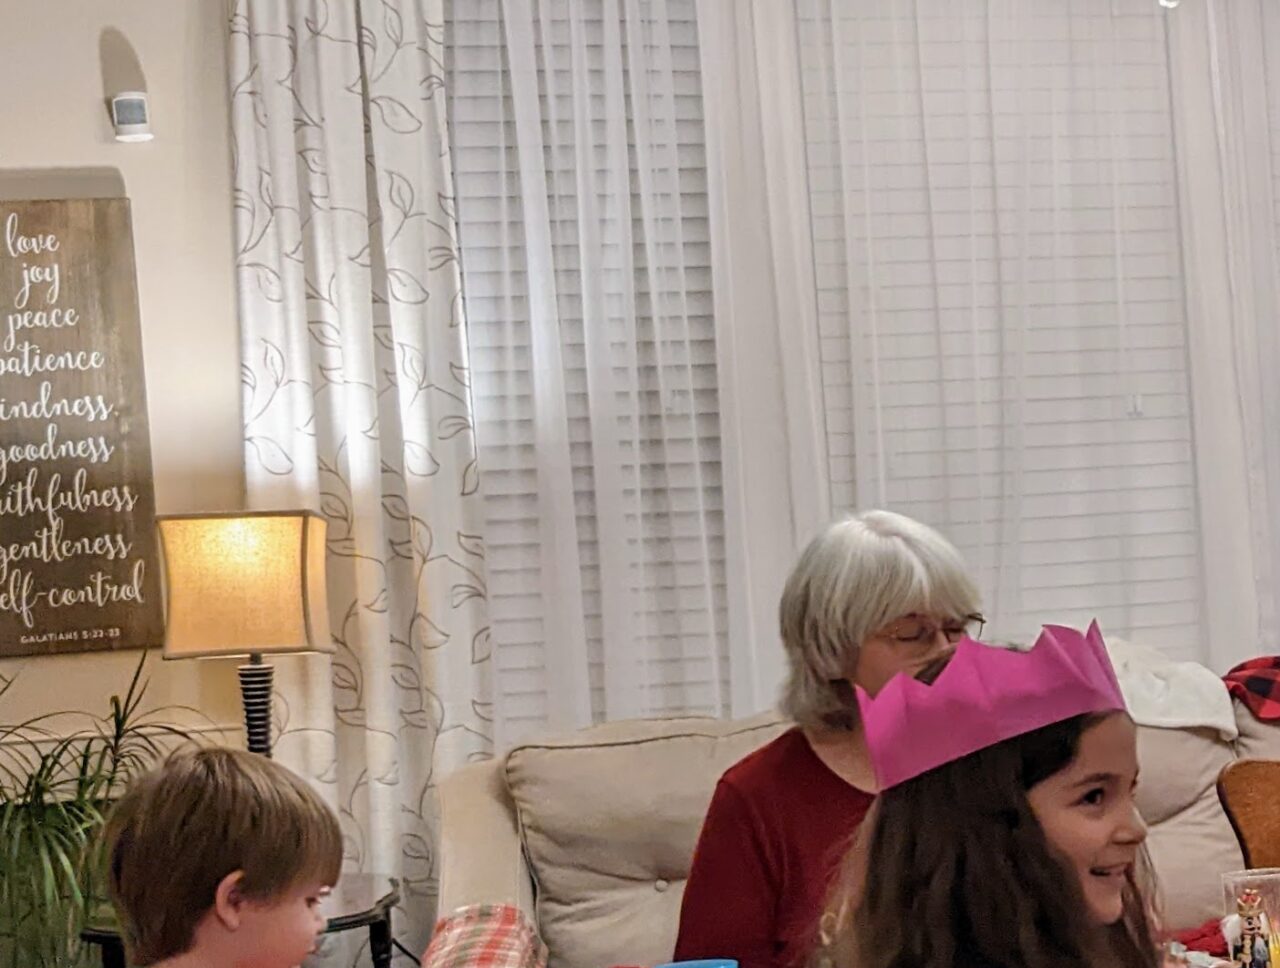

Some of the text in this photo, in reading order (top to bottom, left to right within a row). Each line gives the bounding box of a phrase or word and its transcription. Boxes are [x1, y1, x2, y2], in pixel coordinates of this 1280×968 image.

[6, 213, 60, 257] love
[14, 263, 60, 309] joy
[4, 308, 79, 352] peace
[0, 467, 138, 530] ithfulness
[20, 631, 78, 644] GALATIANS
